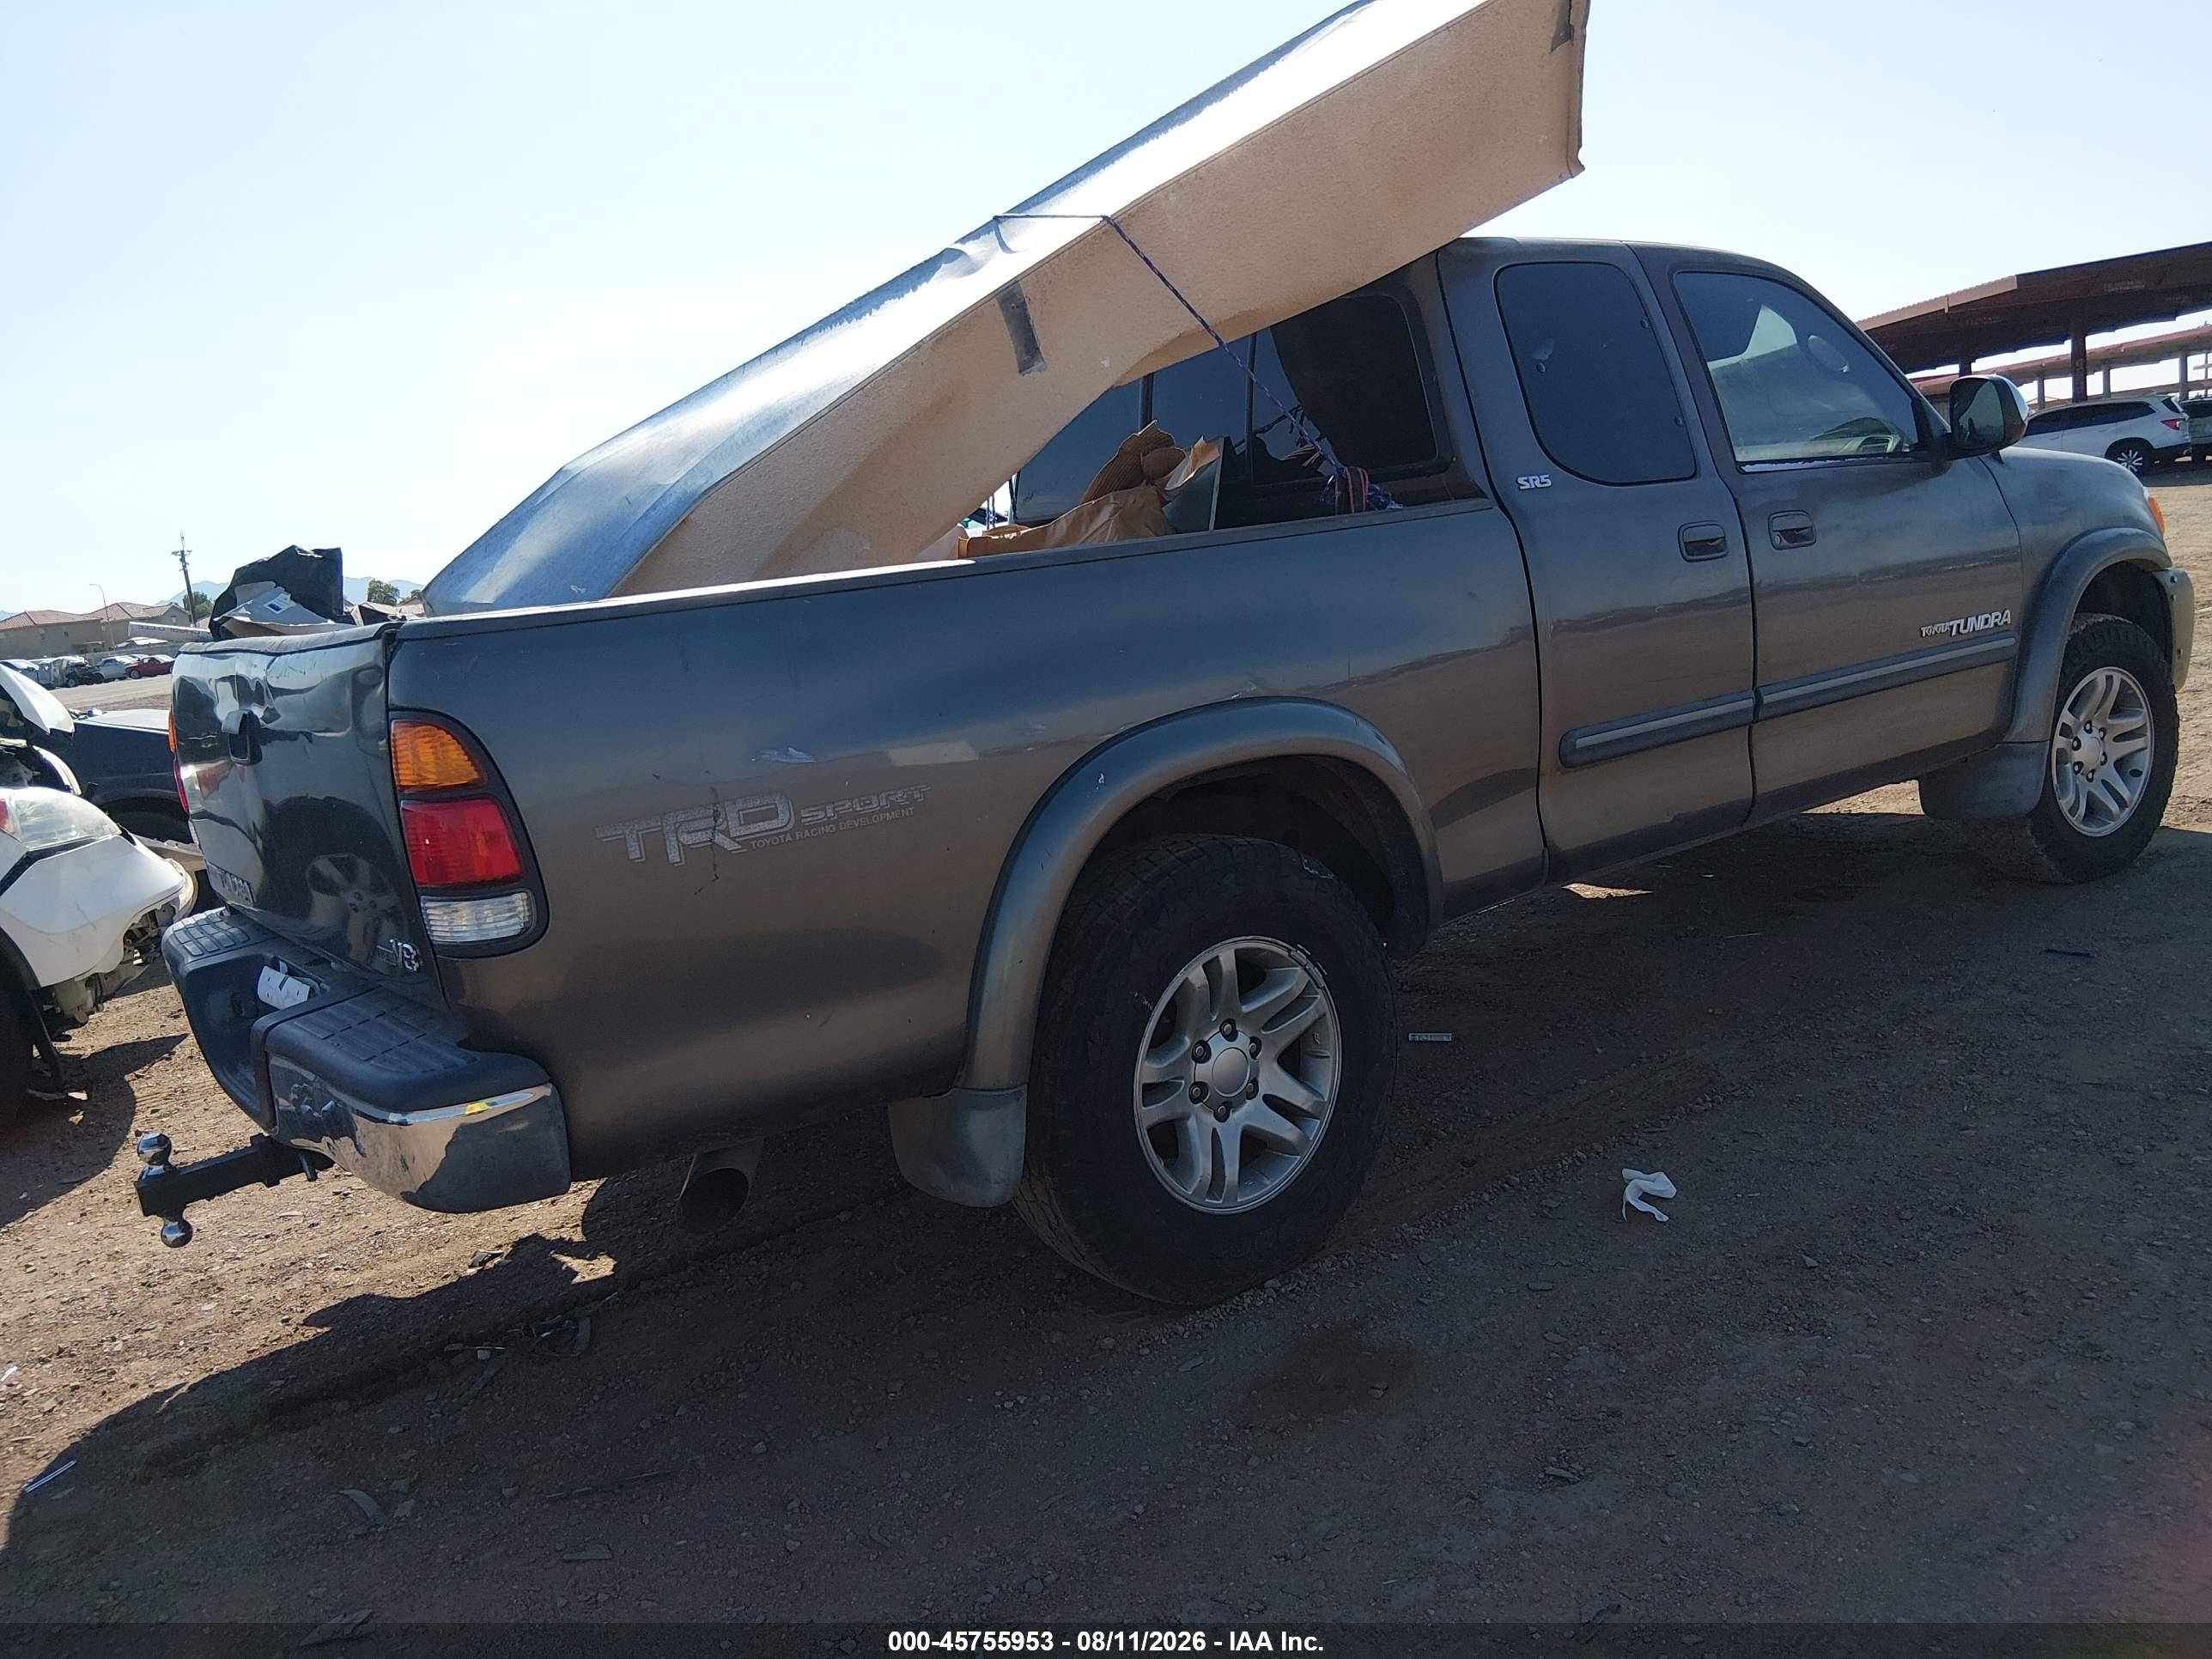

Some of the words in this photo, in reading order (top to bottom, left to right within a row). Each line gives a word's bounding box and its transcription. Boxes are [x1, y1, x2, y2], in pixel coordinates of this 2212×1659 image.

[1517, 474, 1552, 489] SR5
[1920, 623, 1950, 637] TOYOTA
[1949, 609, 2011, 636] TUNDRA
[595, 793, 795, 866] TRD
[800, 783, 933, 825] SPORT
[750, 835, 793, 850] TOYOTA
[796, 824, 836, 841] RACING
[839, 806, 915, 831] DEVELOPMENT
